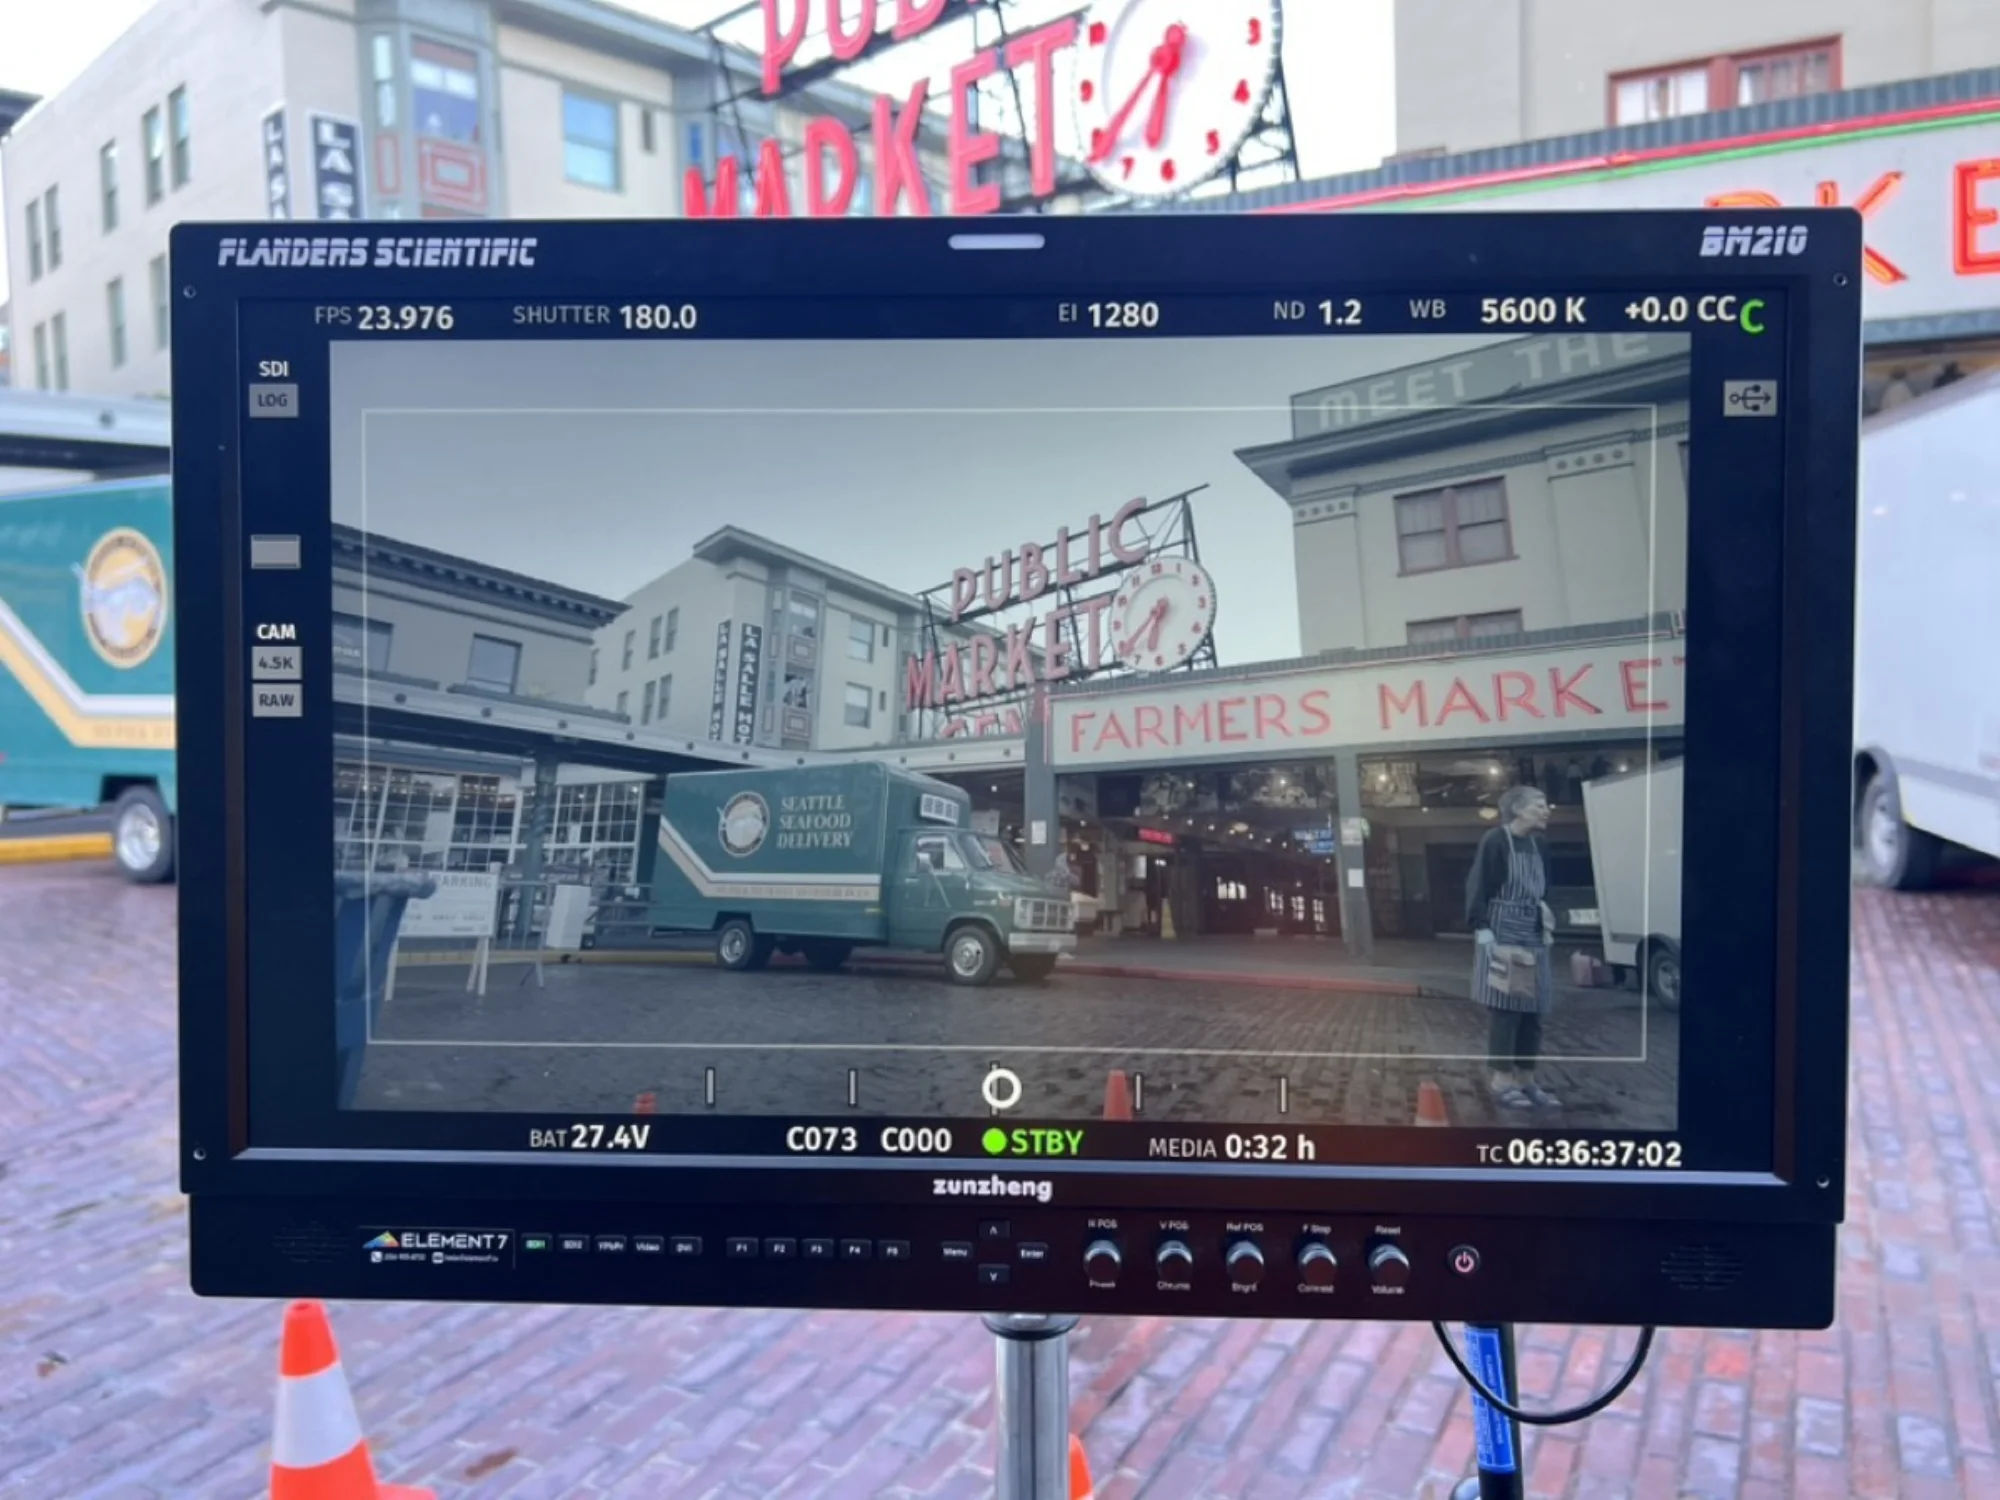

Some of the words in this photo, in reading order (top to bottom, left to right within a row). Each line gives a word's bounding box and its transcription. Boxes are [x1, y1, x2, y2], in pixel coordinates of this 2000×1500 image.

[218, 238, 368, 267] FLANDERS
[373, 238, 537, 267] SCIENTIFIC
[1700, 225, 1808, 256] BM210
[315, 306, 352, 324] FPS
[357, 305, 454, 330] 23.976
[512, 306, 610, 324] SHUTTER
[619, 305, 697, 329] 180.0
[1058, 303, 1077, 321] EI
[1088, 301, 1159, 328] 1280
[1273, 301, 1305, 320] ND
[1318, 299, 1362, 326] 1.2
[1410, 299, 1446, 319] WB
[1480, 297, 1556, 325] 5600
[1564, 297, 1586, 323] K
[1624, 297, 1687, 323] +0.0
[1697, 296, 1737, 322] CC
[1739, 300, 1766, 334] C
[259, 361, 288, 377] SDI
[1319, 361, 1474, 430] MEET
[1514, 334, 1649, 380] THE
[258, 393, 288, 408] LOG
[951, 497, 1150, 621] PUBLIC
[257, 624, 296, 640] CAM
[258, 656, 294, 670] 4.5K
[906, 595, 1112, 711] MARKET
[259, 694, 294, 708] RAW
[1070, 689, 1333, 753] FARMERS
[1377, 656, 1685, 729] MARKE
[781, 795, 845, 811] SEATTLE
[779, 813, 851, 829] SEAFOOD
[776, 832, 854, 849] DELIVERY
[530, 1129, 566, 1149] BAT
[571, 1124, 650, 1151] 27.4V
[786, 1126, 858, 1152] C073
[880, 1126, 953, 1152] C000
[1011, 1129, 1083, 1155] STBY
[1149, 1137, 1217, 1159] MEDIA
[1224, 1134, 1288, 1160] 0:32
[1298, 1133, 1316, 1160] h
[1477, 1144, 1504, 1164] TC
[1507, 1138, 1682, 1168] 06:36:37:02
[932, 1175, 1054, 1202] zunzheng
[401, 1232, 495, 1248] ELEMENT
[497, 1234, 509, 1249] 7
